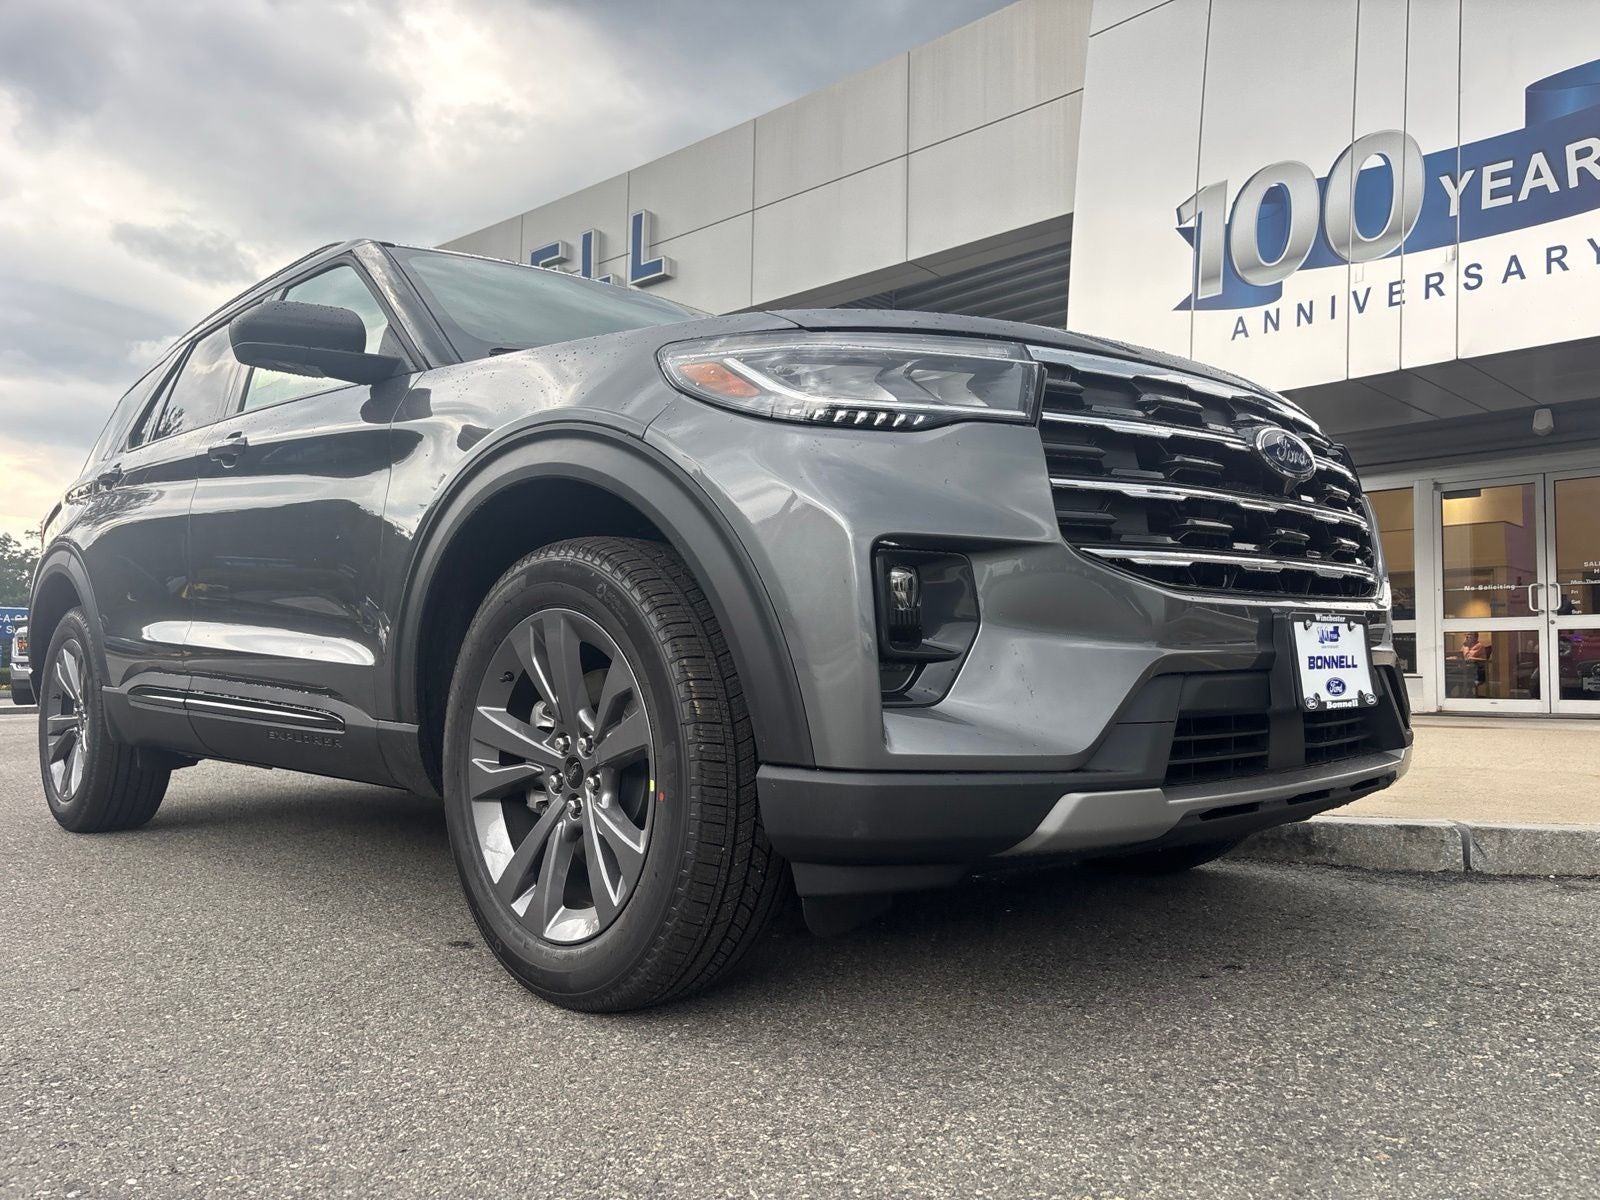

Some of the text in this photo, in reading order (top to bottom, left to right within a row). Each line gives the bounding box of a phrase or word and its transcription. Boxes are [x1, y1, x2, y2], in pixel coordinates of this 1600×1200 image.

[1175, 129, 1600, 300] 100 YEAR
[1315, 613, 1346, 622] Winchester
[1308, 655, 1358, 670] BONNELL
[1326, 700, 1359, 709] Bonnell
